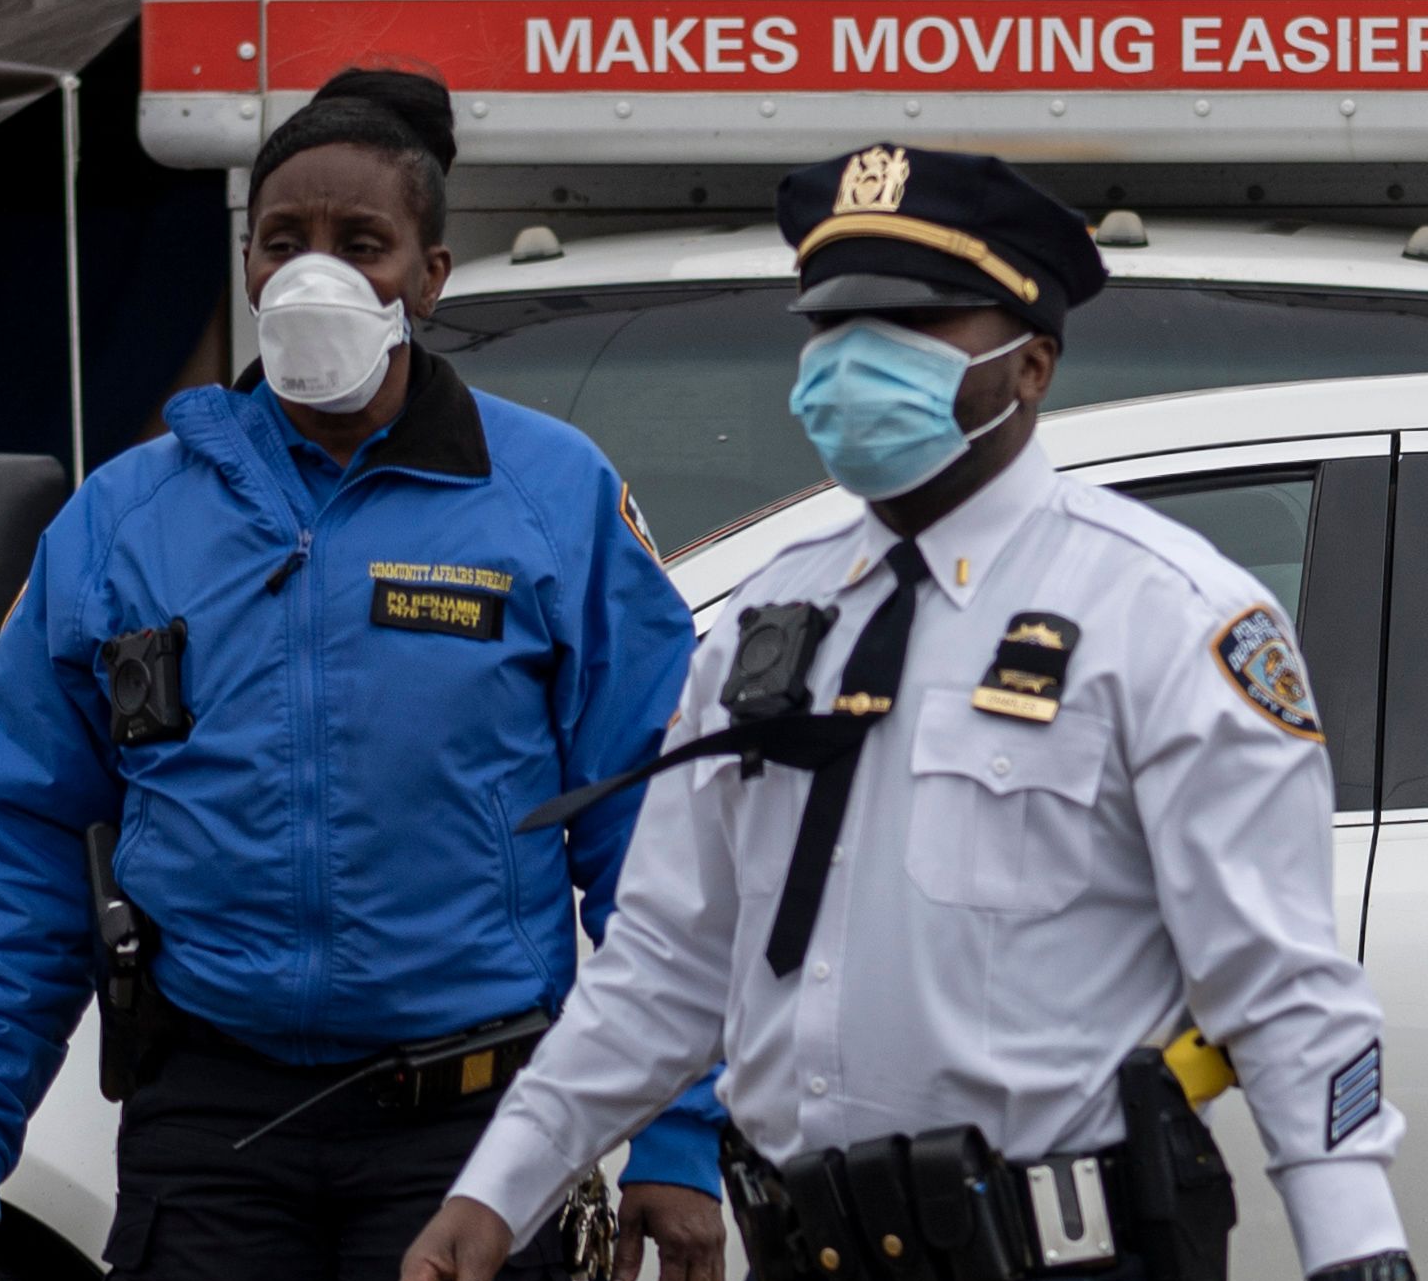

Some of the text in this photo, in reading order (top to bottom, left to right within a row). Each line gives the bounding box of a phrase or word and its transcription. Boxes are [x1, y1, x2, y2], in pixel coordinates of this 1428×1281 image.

[525, 16, 800, 75] MAKES
[831, 15, 1156, 74] MOVING
[431, 564, 475, 584] AFFAIRS
[387, 591, 481, 617] PO BENJAMIN
